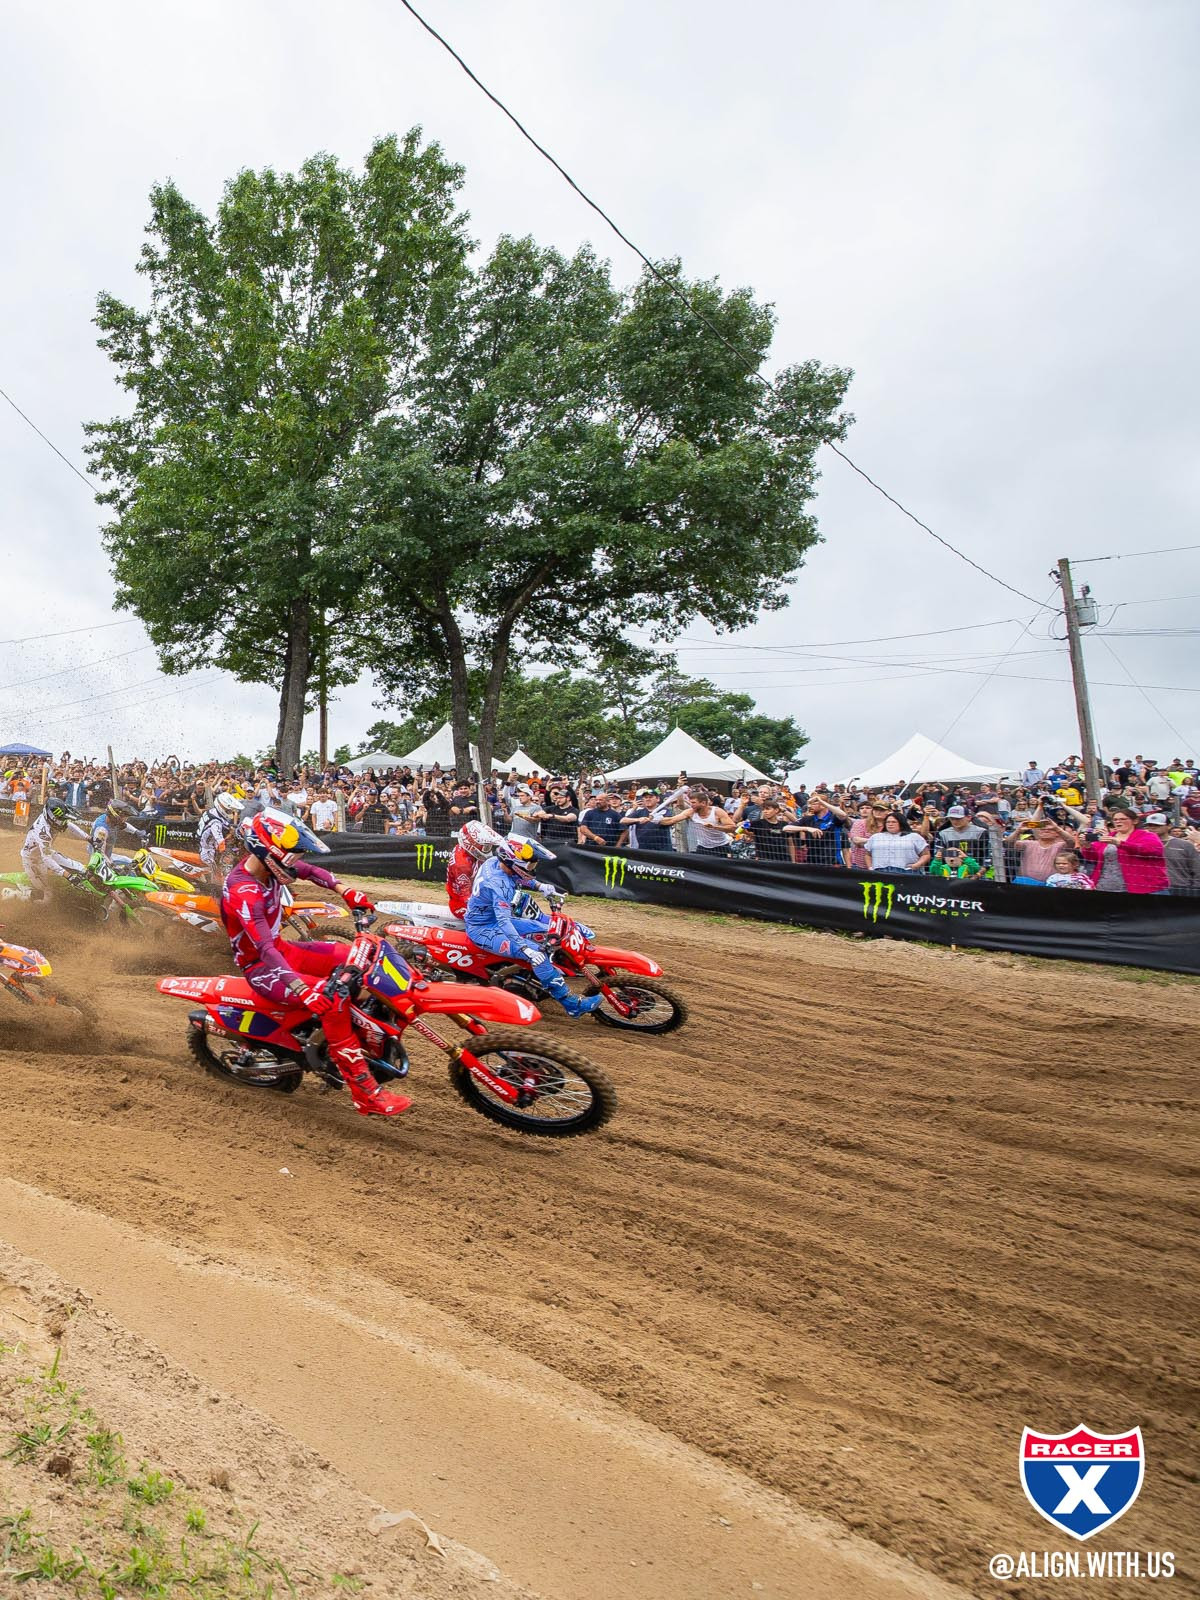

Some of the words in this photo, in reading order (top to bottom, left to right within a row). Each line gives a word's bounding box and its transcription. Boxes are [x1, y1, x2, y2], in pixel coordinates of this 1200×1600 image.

[20, 803, 27, 815] 4
[627, 864, 686, 878] MONSTER
[635, 875, 676, 883] ENERGY
[896, 893, 985, 912] MONSTER
[909, 906, 971, 917] ENERGY
[441, 942, 468, 951] HONDA
[446, 949, 474, 967] 96
[382, 955, 409, 991] 1
[221, 996, 255, 1006] HONDA
[238, 1010, 256, 1033] 1
[469, 1066, 509, 1096] DUNLOP
